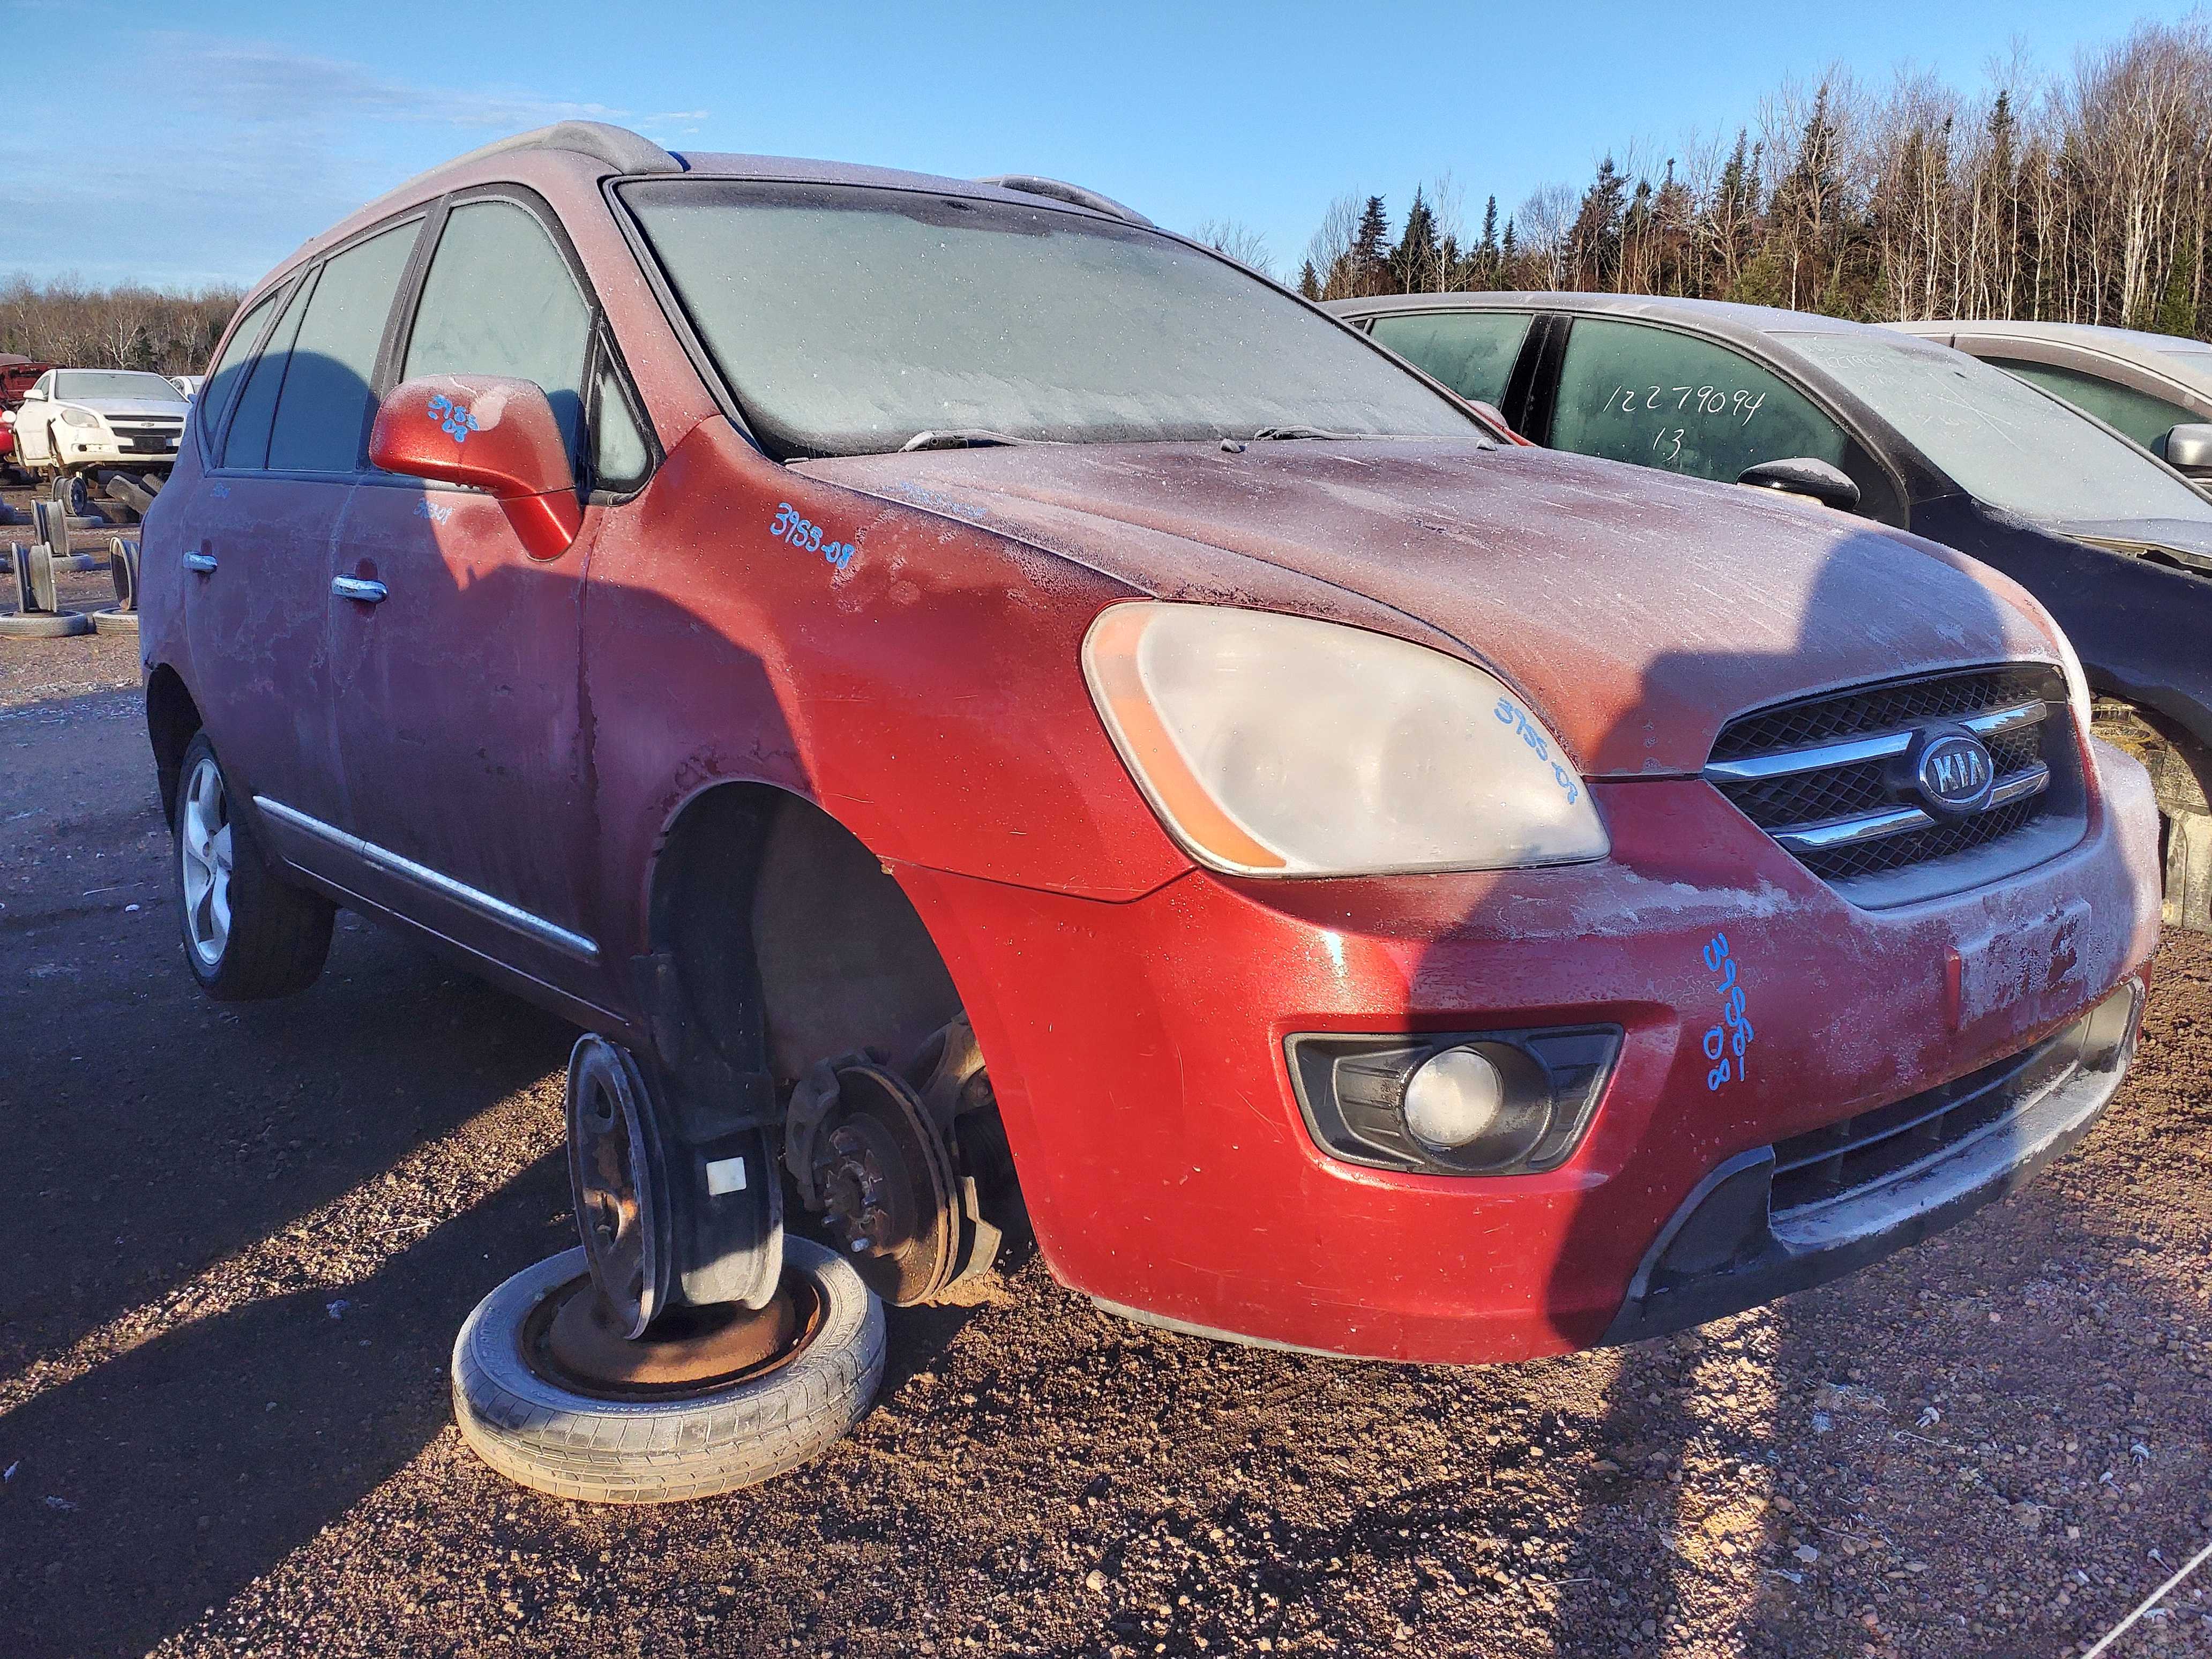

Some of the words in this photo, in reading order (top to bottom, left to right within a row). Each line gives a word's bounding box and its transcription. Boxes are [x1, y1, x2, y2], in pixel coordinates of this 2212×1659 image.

[1603, 385, 1767, 424] 12279094
[1652, 427, 1684, 462] 13
[1932, 750, 1986, 793] KIA
